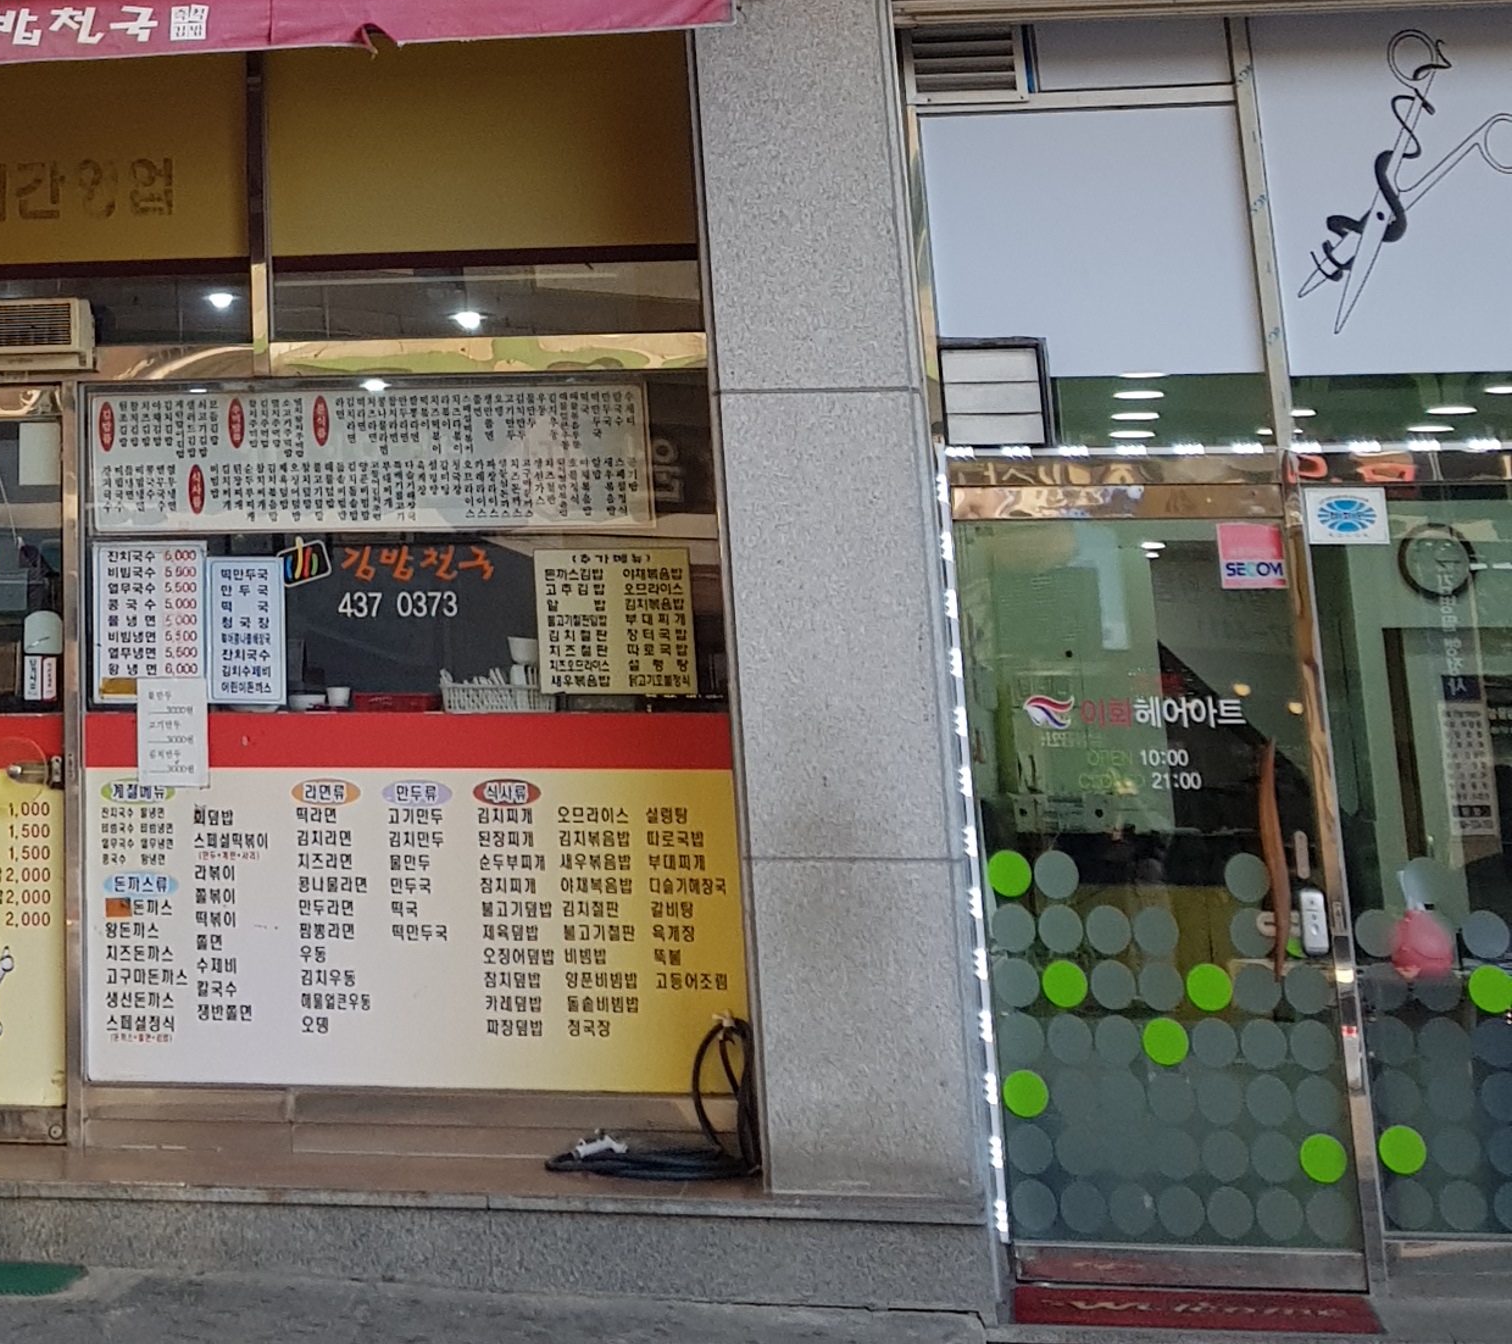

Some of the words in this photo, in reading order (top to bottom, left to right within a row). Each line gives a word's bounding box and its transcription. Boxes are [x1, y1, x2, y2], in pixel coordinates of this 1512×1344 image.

[341, 545, 494, 582] 김밥천국
[1226, 563, 1283, 576] SECOM
[339, 593, 381, 617] 437
[397, 591, 457, 617] 0373
[1140, 749, 1189, 766] 10:00
[1152, 772, 1202, 790] 21:00
[305, 784, 345, 800] 라면류
[396, 785, 437, 801] 만두류
[485, 784, 528, 802] 식사류
[8, 801, 50, 817] 1,000
[296, 808, 336, 824] 떡라면
[388, 808, 443, 825] 고기만두
[478, 808, 533, 824] 김치찌개
[558, 807, 629, 824] 오므라이스
[8, 823, 50, 839] 1,500
[297, 830, 351, 847] 김치라면
[389, 831, 443, 848] 김치만두
[479, 831, 534, 848] 된장찌개
[559, 831, 629, 848] 김치볶음밥
[194, 832, 268, 849] 스페셜떡볶이
[8, 845, 50, 861] 1,500
[298, 853, 352, 870] 치즈라면
[480, 854, 545, 871] 순두부찌개
[560, 854, 631, 871] 새우볶음밥
[649, 854, 705, 871] 부대찌개
[6, 866, 50, 883] 2,000
[195, 865, 235, 881] 라볶이
[114, 876, 168, 893] 돈까스류
[298, 876, 368, 893] 콩나물라면
[391, 877, 431, 894] 만두국
[480, 877, 536, 894] 참치찌개
[6, 888, 50, 905] 2,000
[299, 900, 354, 916] 만두라면
[391, 901, 417, 917] 떡국
[482, 901, 552, 918] 불고기덮밥
[562, 901, 619, 918] 김치철판
[651, 901, 693, 919] 갈비탕
[5, 911, 50, 927] 2,000
[196, 911, 236, 928] 떡볶이
[106, 923, 159, 939] 왕돈까스
[392, 924, 447, 941] 떡만두국
[483, 924, 538, 941] 제육덮밥
[564, 925, 635, 941] 불고기철판
[107, 946, 173, 962] 치즈돈까스
[300, 946, 326, 963] 우동
[484, 947, 554, 965] 오징어덮밥
[565, 949, 606, 965] 비빔밥
[197, 958, 237, 974] 수제비
[107, 968, 188, 986] 고구마돈까스
[301, 970, 356, 986] 김치우동
[484, 972, 540, 989] 참치덮밥
[566, 972, 637, 989] 양푼비빔밥
[197, 981, 237, 997] 칼국수
[107, 992, 174, 1009] 생선돈까스
[486, 995, 541, 1012] 카레덮밥
[197, 1004, 252, 1022] 쟁반쫄면
[107, 1015, 175, 1032] 스페셜정식
[302, 1016, 328, 1034] 오뎅
[568, 1019, 610, 1037] 청국장
